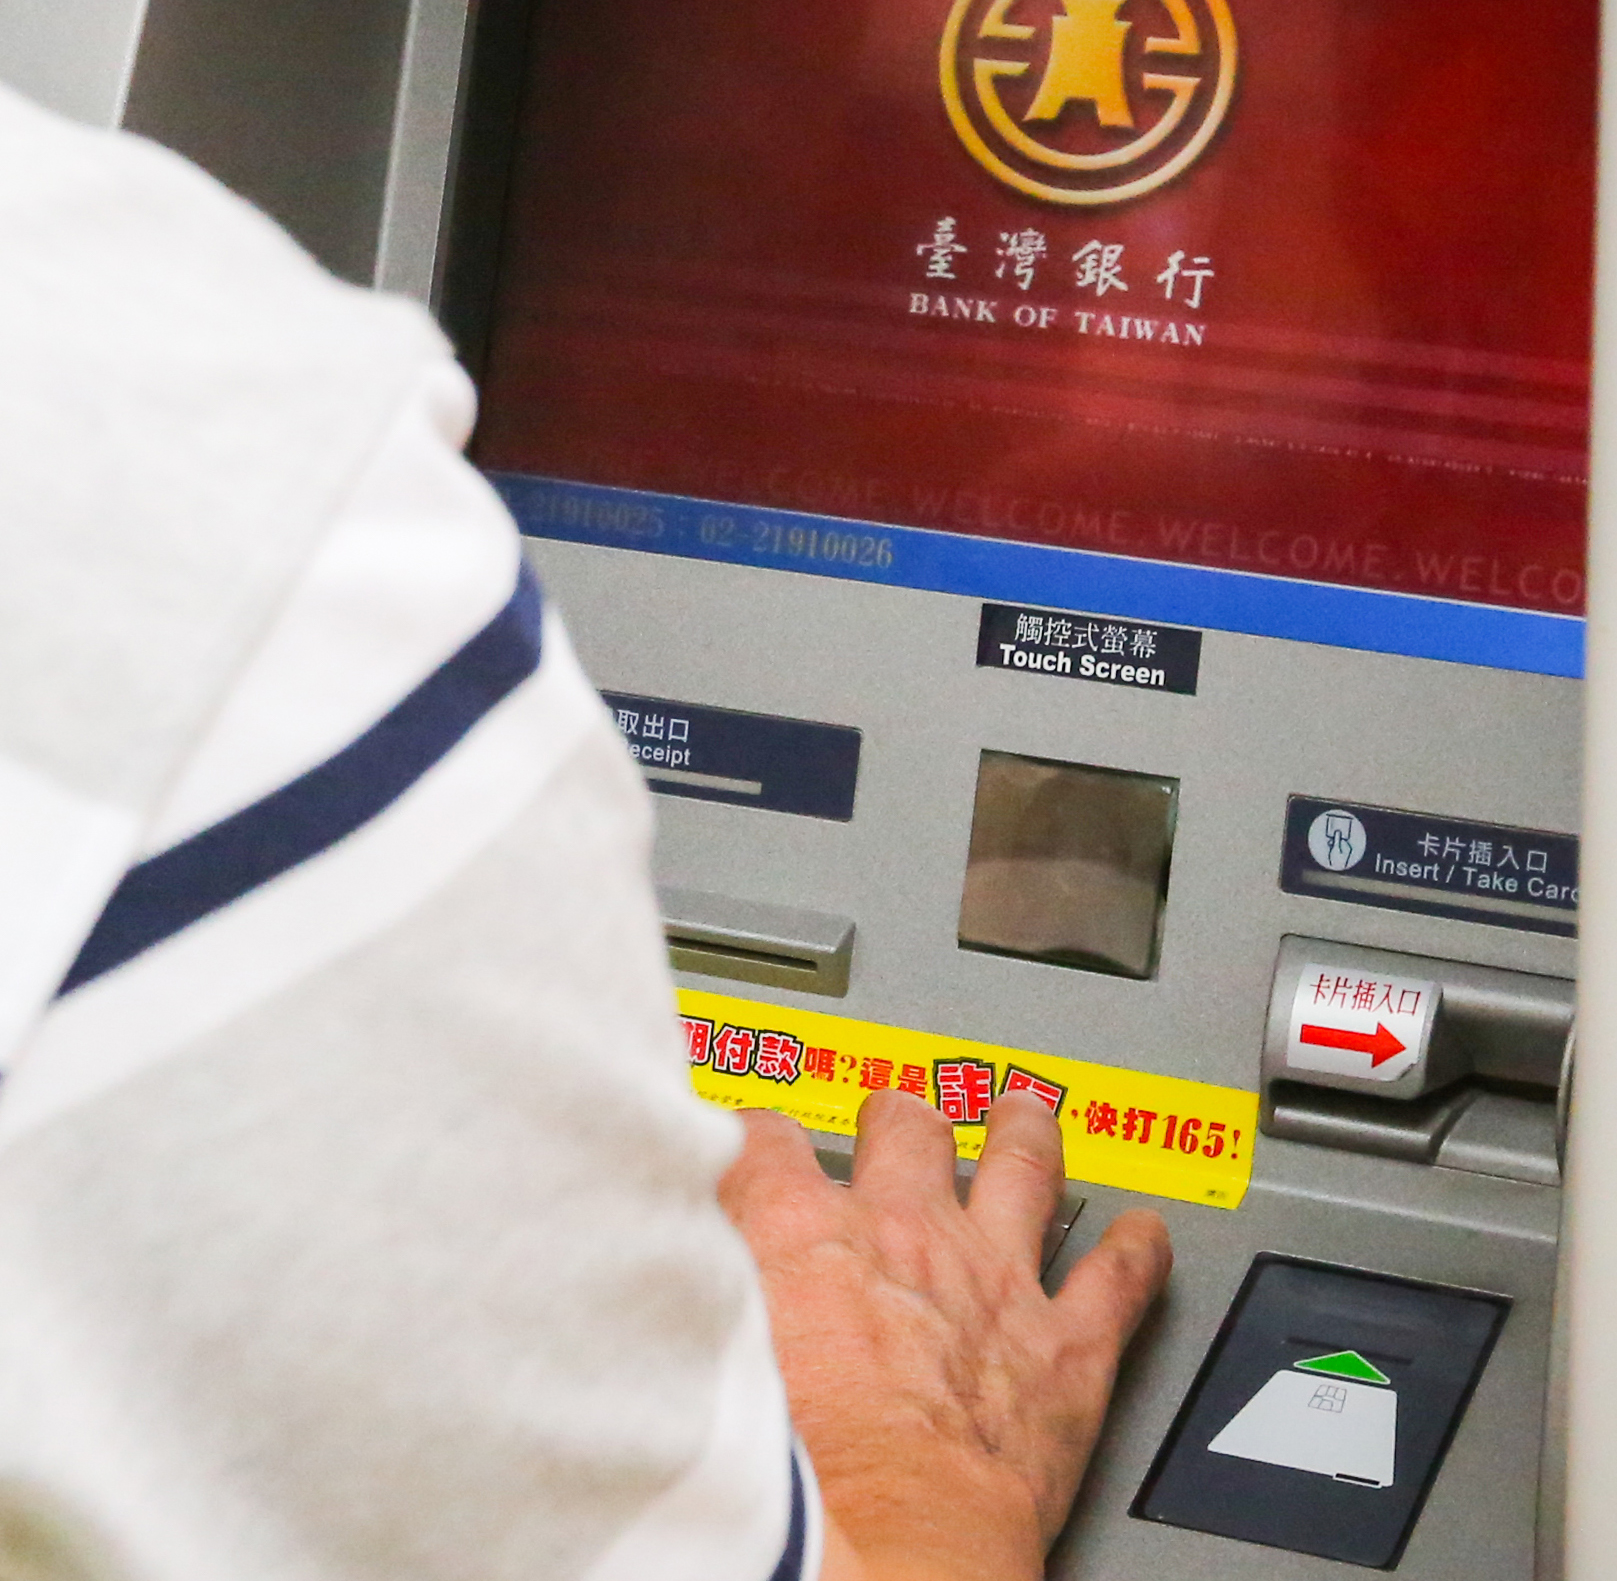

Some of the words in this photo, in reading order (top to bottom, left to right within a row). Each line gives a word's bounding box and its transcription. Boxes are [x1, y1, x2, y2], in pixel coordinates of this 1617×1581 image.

[916, 216, 1215, 309] 臺灣銀行
[909, 292, 998, 323] BANK
[1013, 305, 1057, 329] OF
[1075, 311, 1206, 347] TAIWAN
[1014, 613, 1158, 659] 觸控式螢幕
[999, 643, 1072, 674] Touch
[1079, 654, 1166, 687] Screen
[610, 709, 690, 743] 取出口
[1375, 853, 1440, 882] Insert
[1463, 867, 1519, 894] Take
[1417, 832, 1548, 874] 卡片插入口
[1310, 973, 1421, 1016] 卡片插入口
